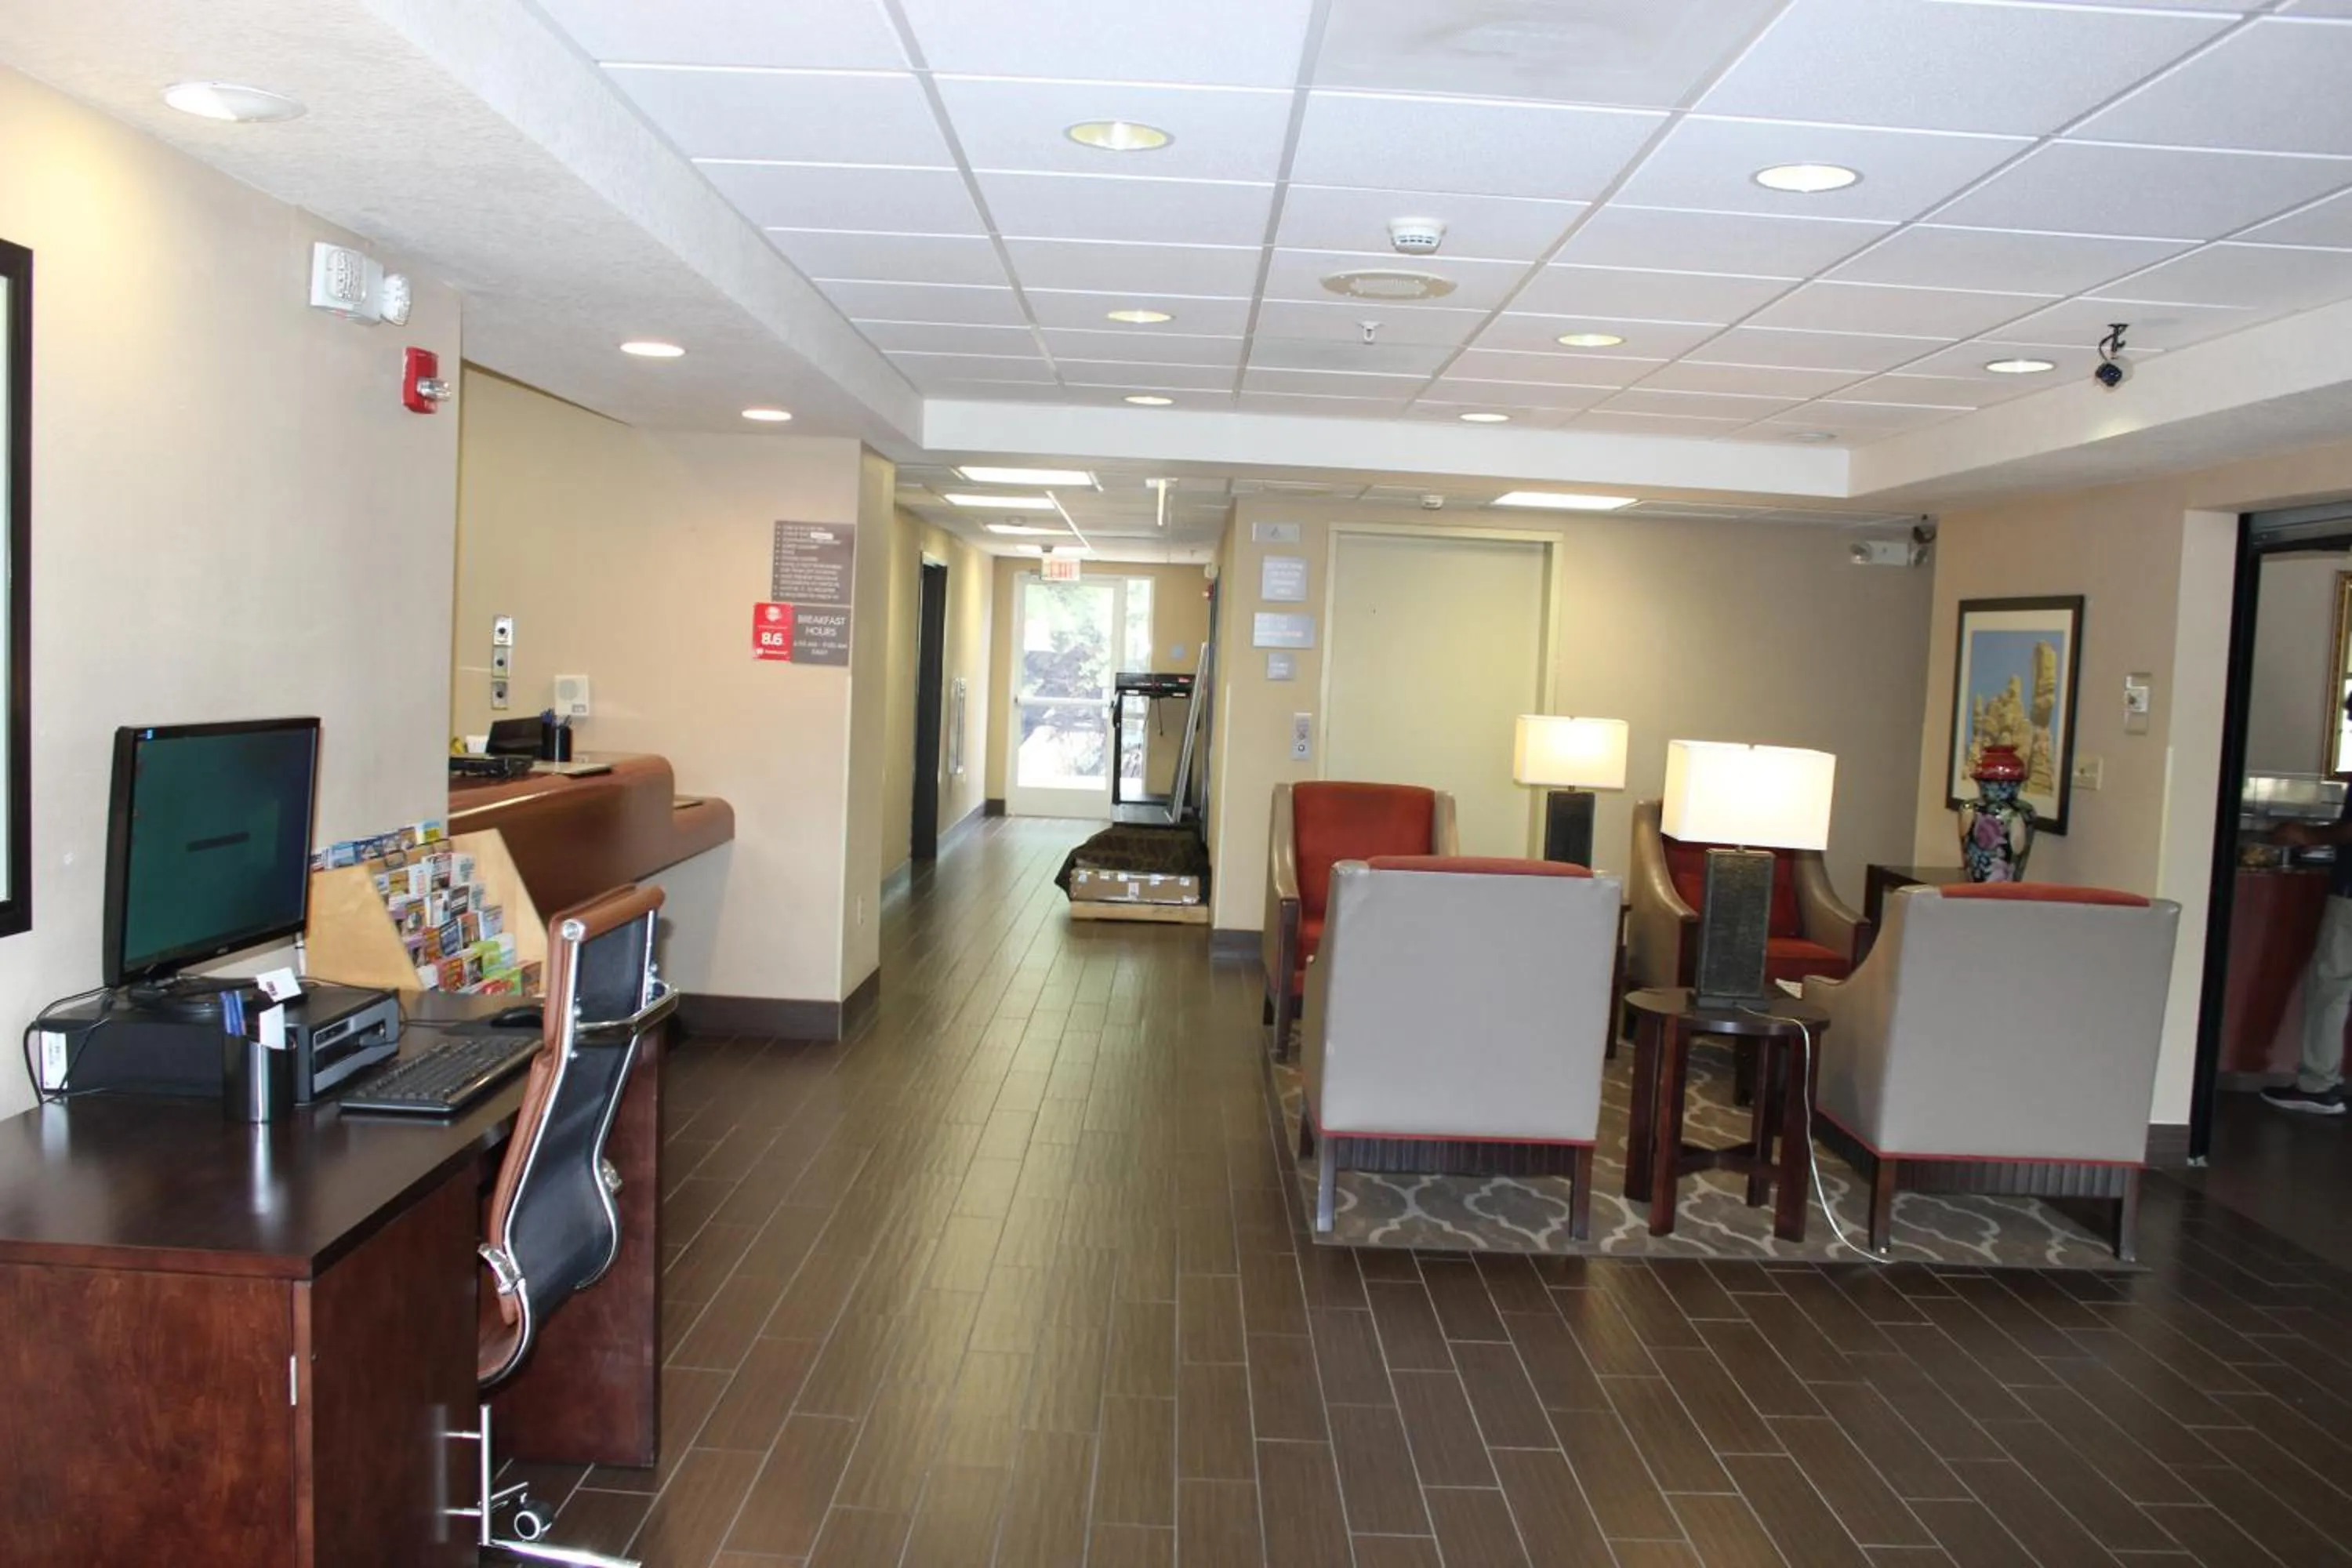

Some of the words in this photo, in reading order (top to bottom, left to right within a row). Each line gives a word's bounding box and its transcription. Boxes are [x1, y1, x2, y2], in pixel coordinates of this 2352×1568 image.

[797, 614, 846, 626] BREAKFAST
[805, 626, 837, 637] HOURS
[761, 632, 783, 645] 8.6
